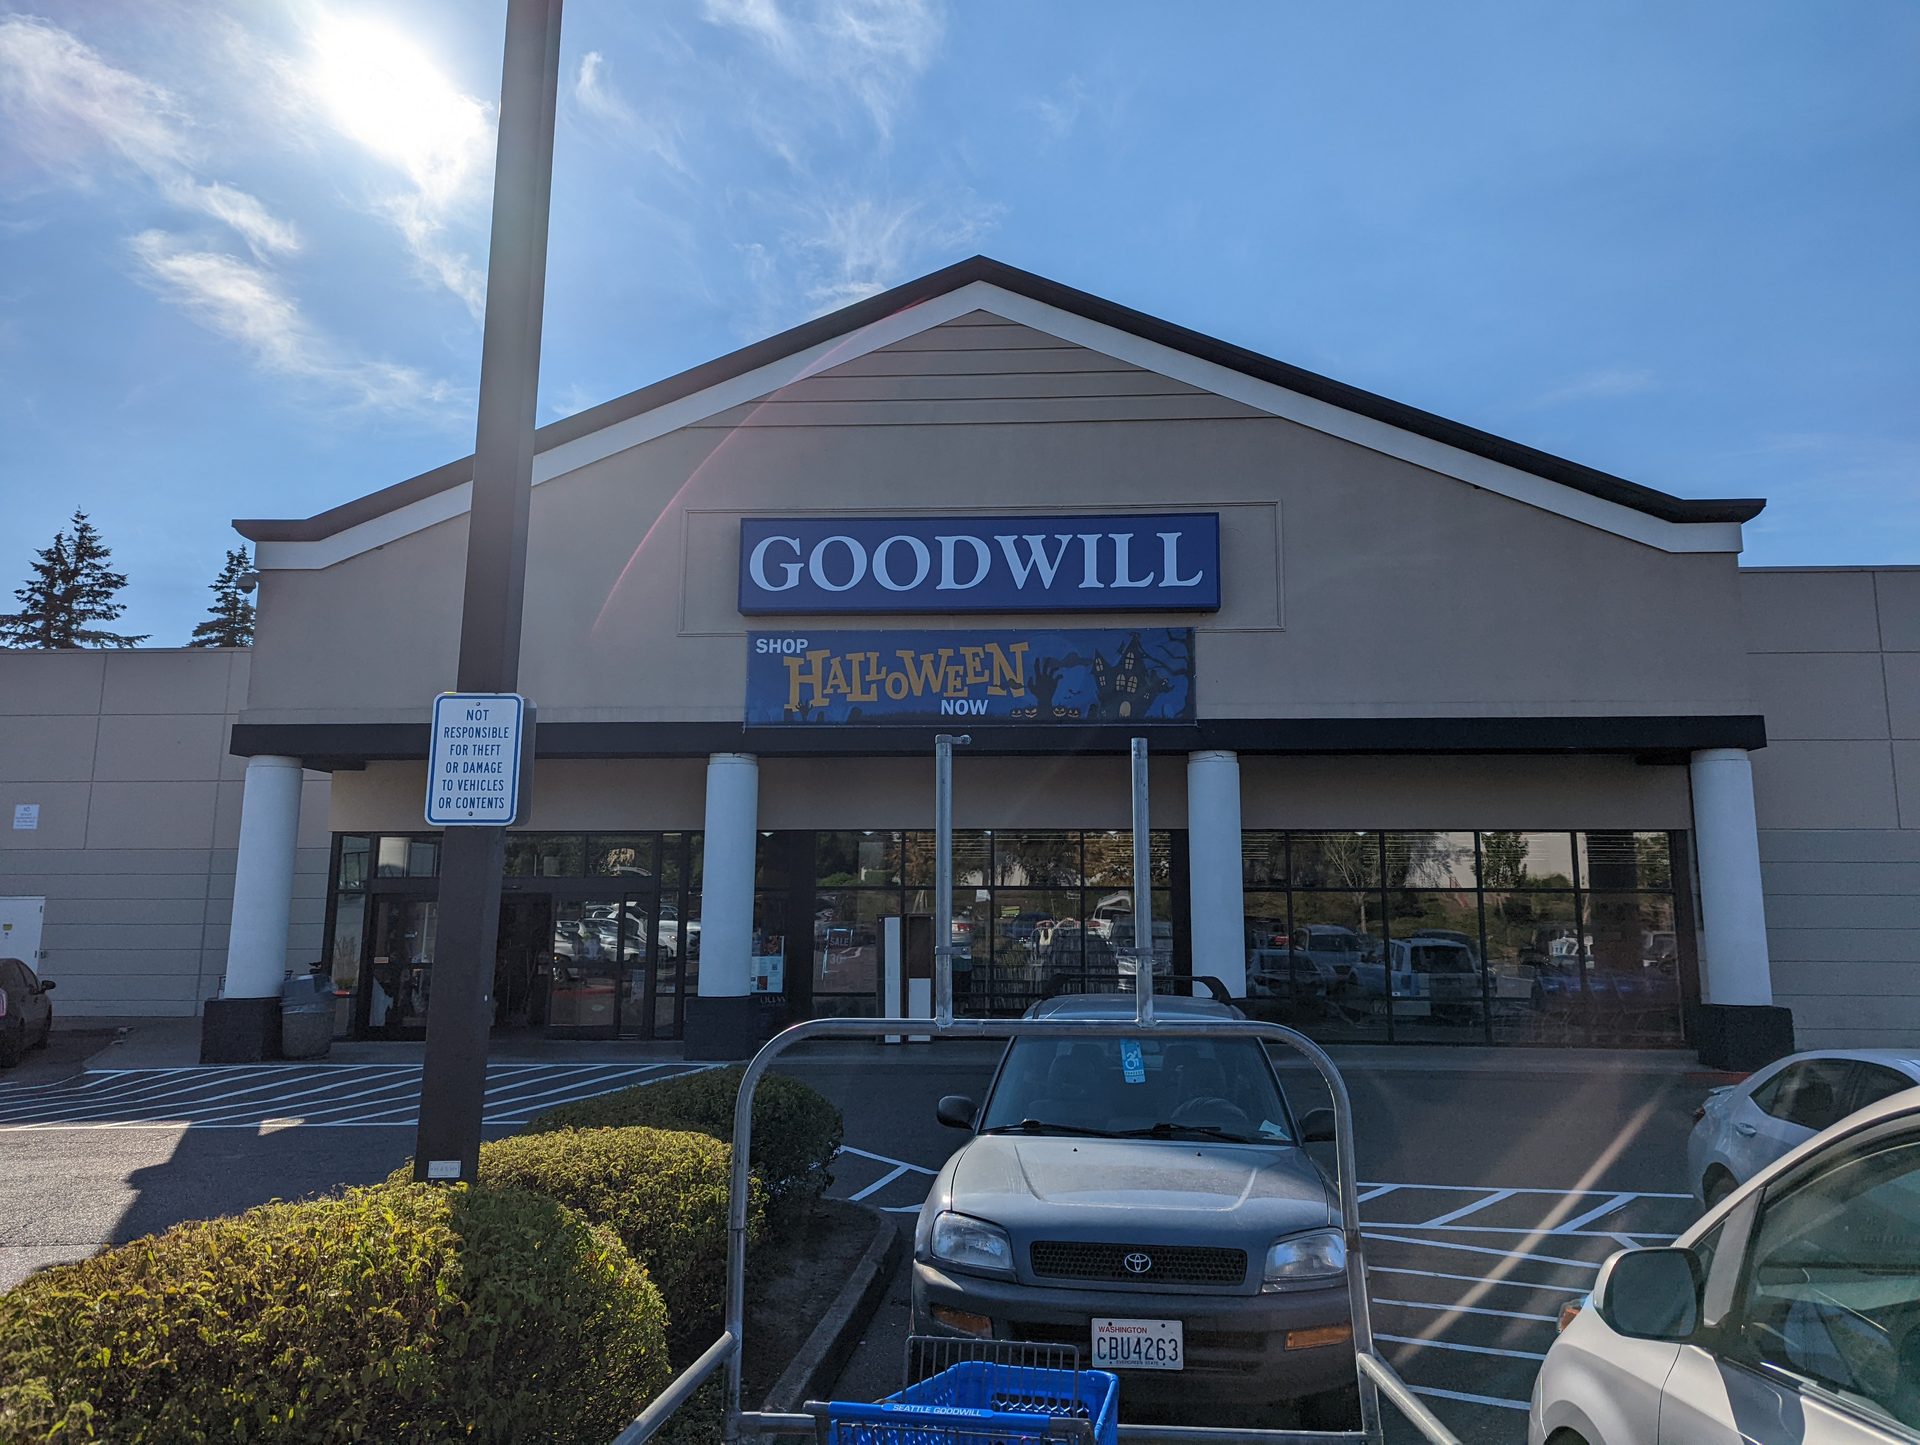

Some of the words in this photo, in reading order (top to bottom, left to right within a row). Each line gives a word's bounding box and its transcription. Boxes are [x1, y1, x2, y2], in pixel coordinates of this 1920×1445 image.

[749, 532, 1203, 591] GOODWILL
[755, 638, 809, 654] SHOP
[783, 642, 1029, 712] HALLOWEEN
[940, 699, 988, 715] NOW
[466, 710, 489, 721] NOT
[444, 727, 509, 738] RESPONSIBLE
[450, 744, 468, 756] FOR
[472, 744, 501, 756] THEFT
[445, 762, 459, 773] OR
[463, 762, 503, 773] DAMAGE
[442, 780, 453, 791] TO
[457, 780, 504, 791] VEHICLES
[438, 797, 452, 808] OR
[455, 797, 504, 809] CONTENTS
[830, 937, 849, 947] SALE
[1098, 1326, 1147, 1334] WASHINGTON
[1097, 1337, 1178, 1361] CBU4263
[892, 1404, 931, 1413] SEATTLE
[933, 1407, 981, 1416] GOODWILL
